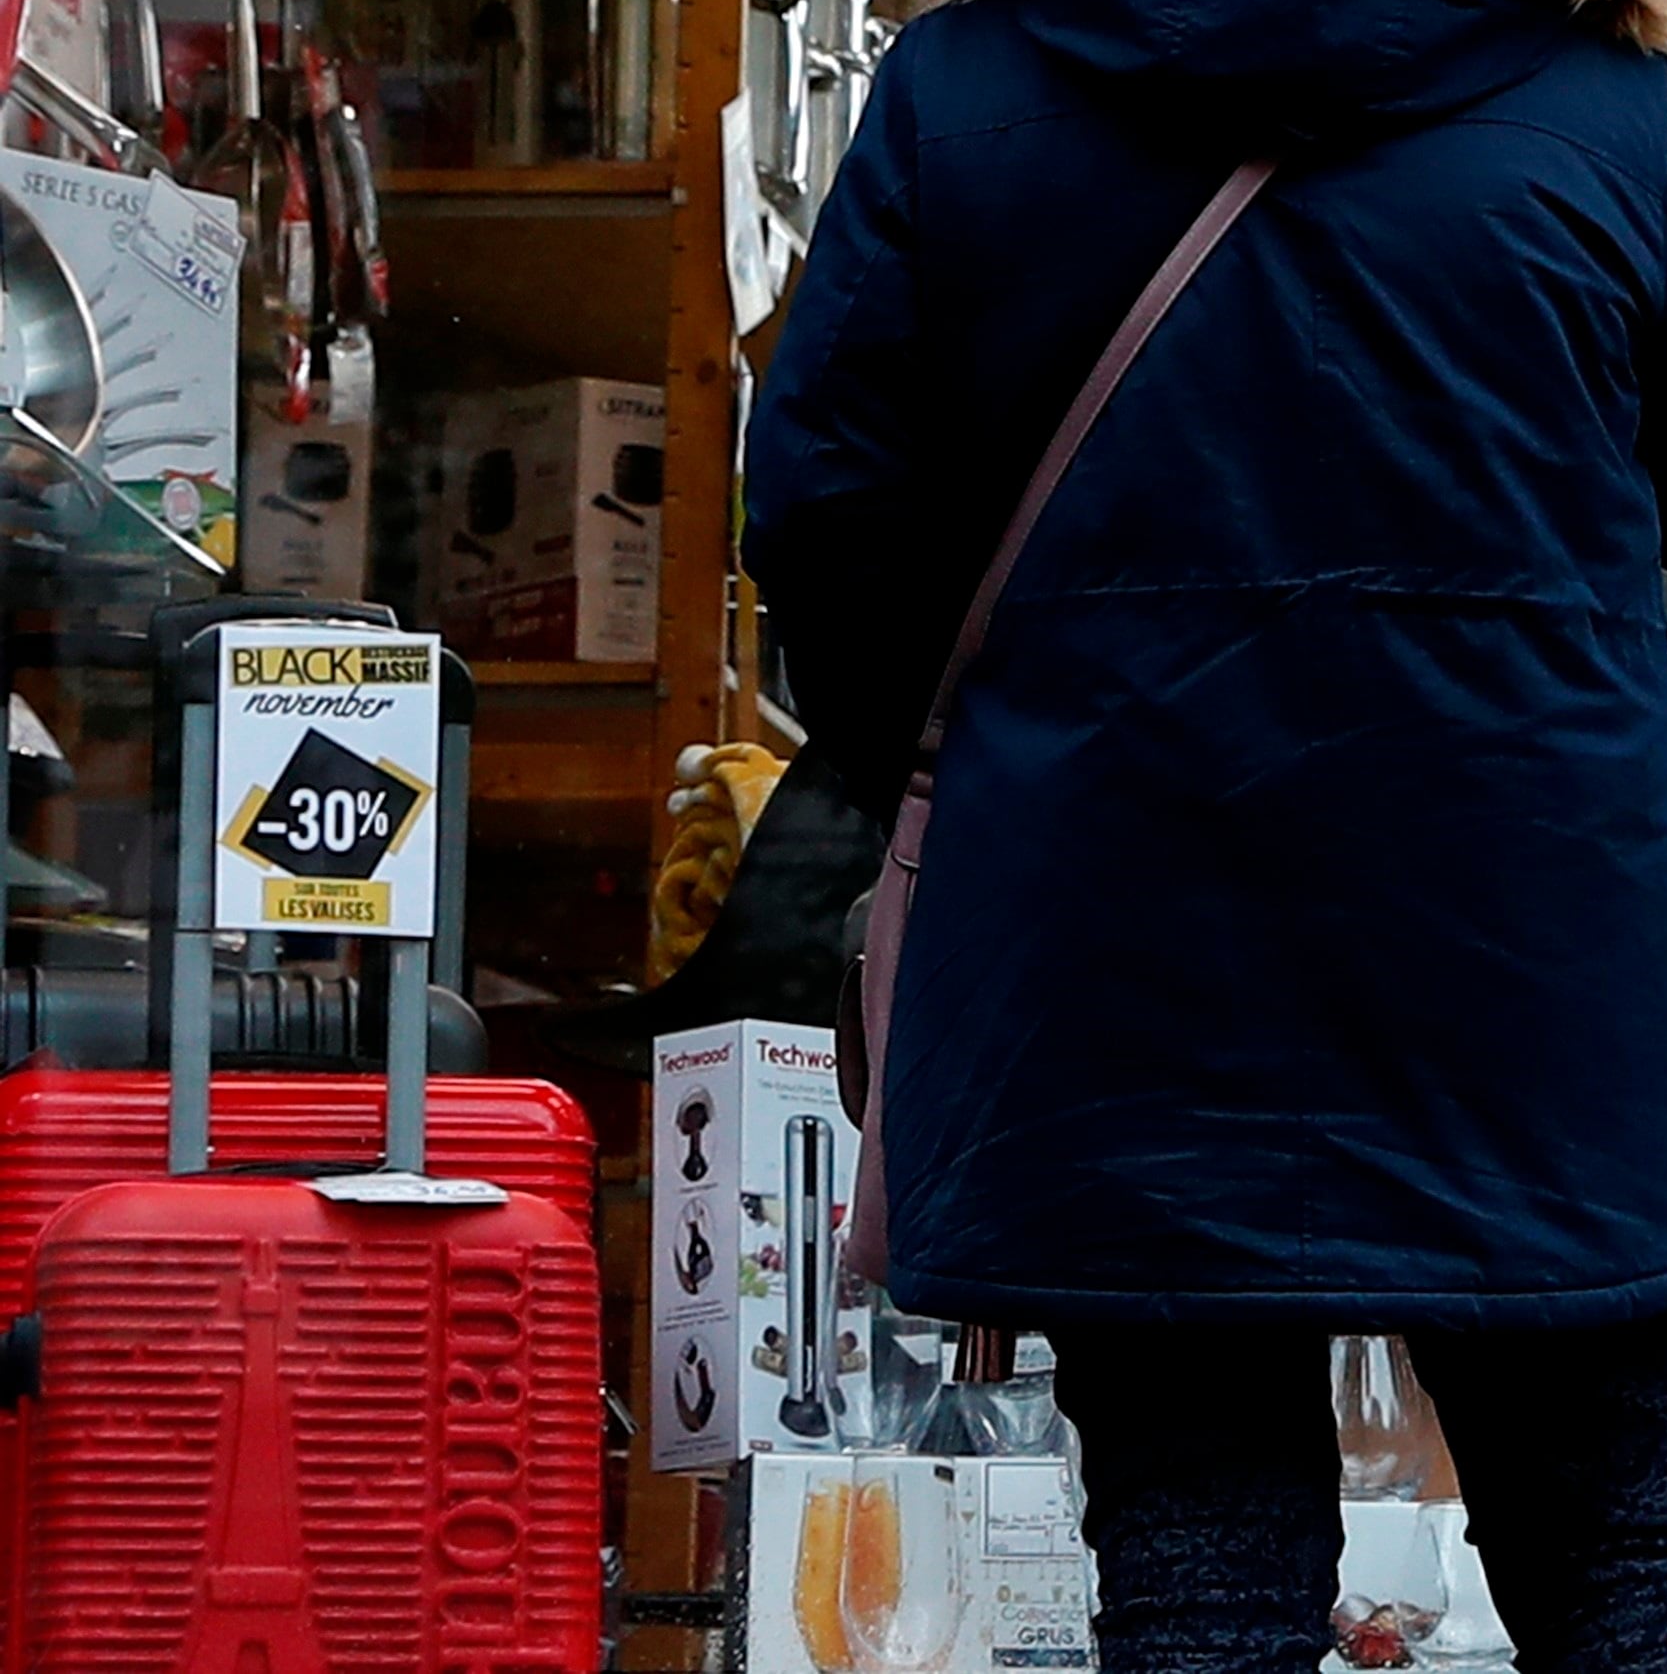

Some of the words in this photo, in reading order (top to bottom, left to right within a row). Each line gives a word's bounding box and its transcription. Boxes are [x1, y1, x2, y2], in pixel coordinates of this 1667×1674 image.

[21, 173, 79, 203] SERIE
[232, 647, 358, 685] BLACK
[362, 661, 430, 683] MASSIF
[244, 685, 394, 718] november
[257, 787, 389, 853] -30%
[278, 898, 306, 918] LES
[310, 900, 375, 921] VALISES
[659, 1042, 734, 1073] Techwood
[756, 1038, 836, 1068] Techwo
[1017, 1626, 1075, 1645] GRUS
